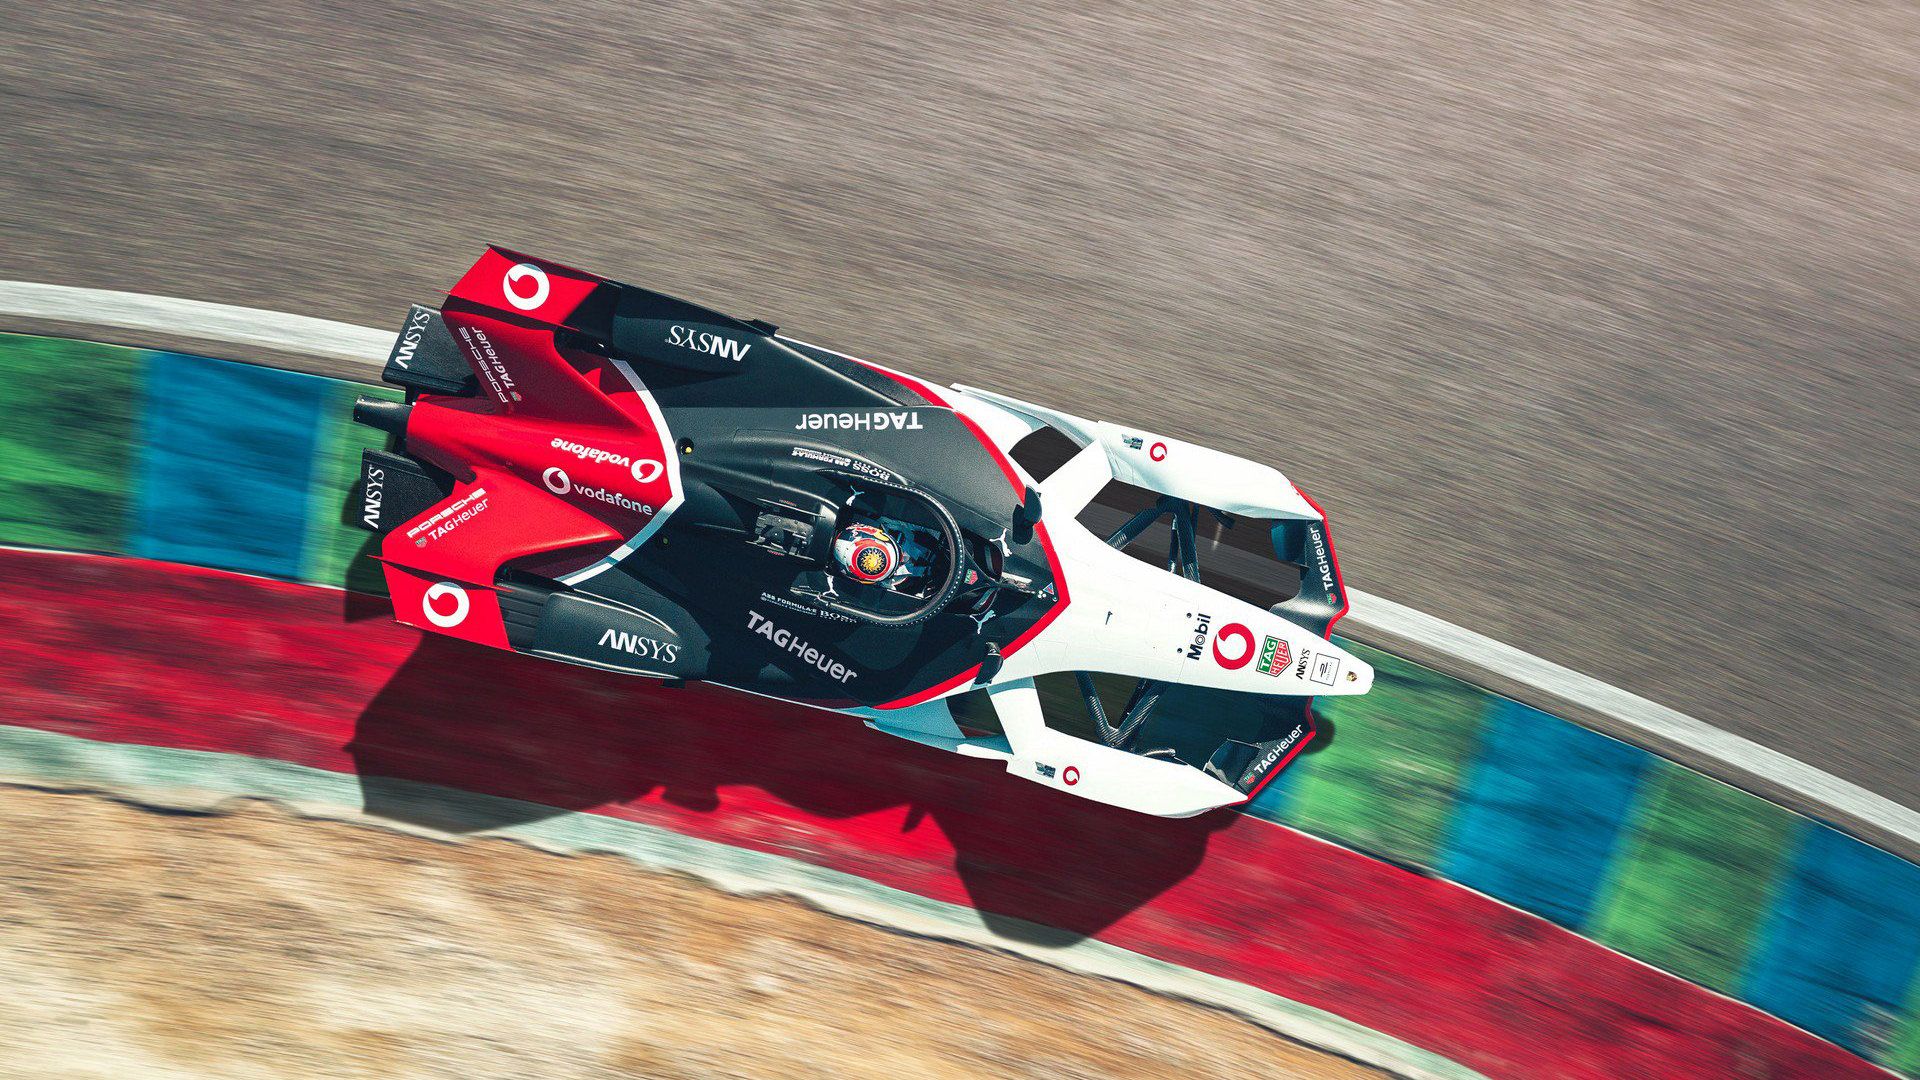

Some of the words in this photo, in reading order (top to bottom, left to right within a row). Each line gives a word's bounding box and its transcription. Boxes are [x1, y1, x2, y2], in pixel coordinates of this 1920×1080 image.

[395, 311, 430, 369] ANSYS
[668, 325, 751, 361] ANSYS
[459, 326, 508, 403] PORSCHE
[551, 438, 630, 467] vodafone
[364, 467, 384, 529] ANSYS
[407, 488, 486, 538] PORSCHE
[574, 484, 652, 515] vodafone
[598, 629, 677, 663] ANSYS
[1187, 613, 1211, 660] Mobil
[1260, 641, 1277, 669] TAG
[1272, 642, 1289, 673] HEUER
[1296, 649, 1310, 679] ANSYS
